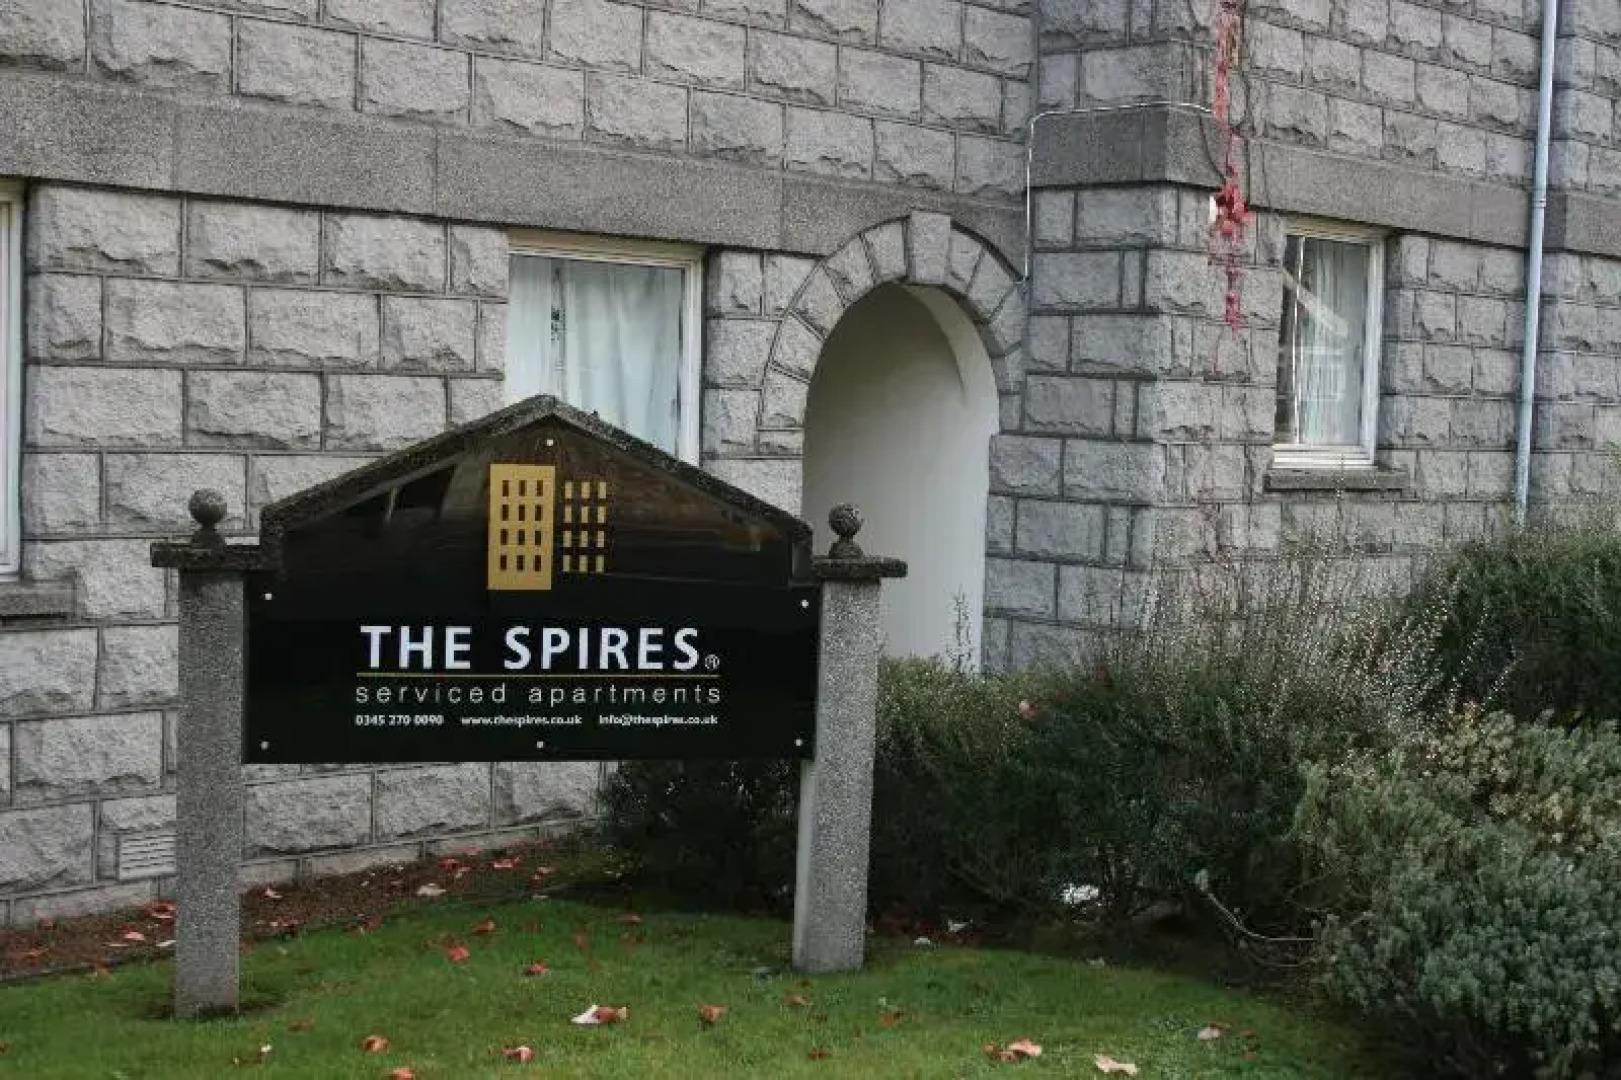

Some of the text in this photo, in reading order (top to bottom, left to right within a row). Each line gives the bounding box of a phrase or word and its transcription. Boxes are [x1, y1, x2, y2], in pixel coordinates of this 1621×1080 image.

[360, 625, 472, 670] THE
[355, 682, 721, 708] serviced apartments
[461, 714, 583, 728] www.thespires.co.uk
